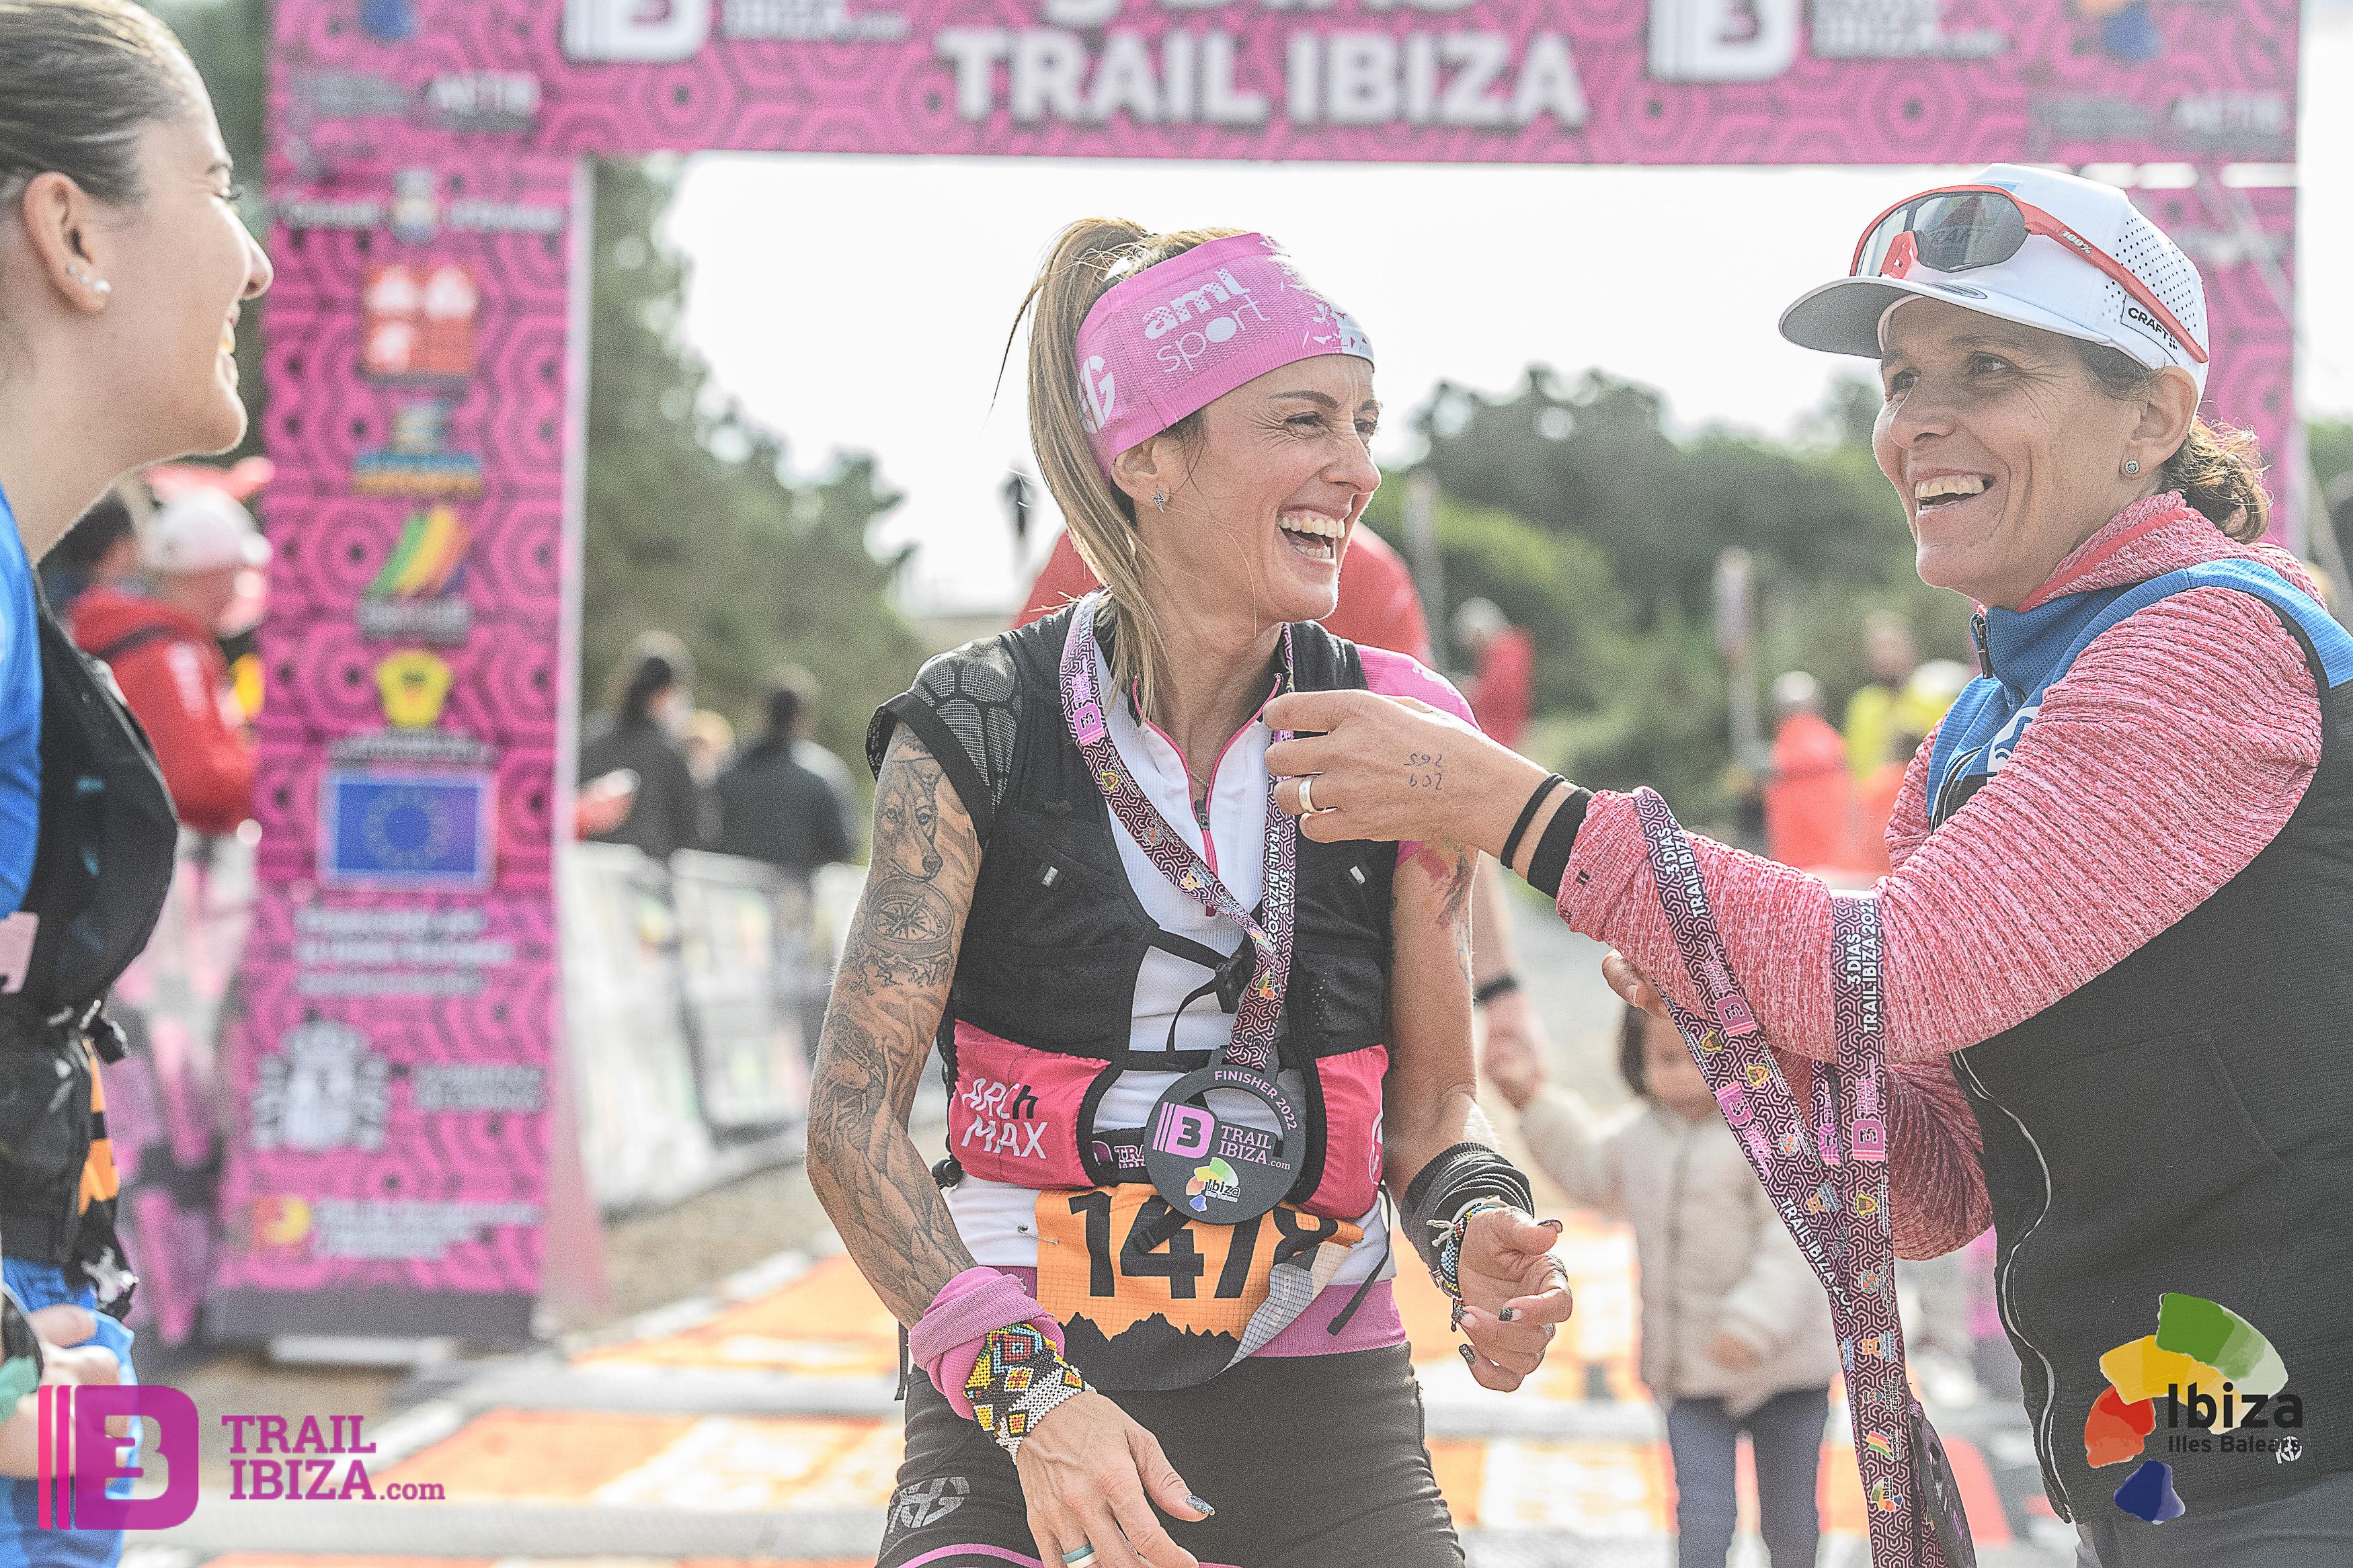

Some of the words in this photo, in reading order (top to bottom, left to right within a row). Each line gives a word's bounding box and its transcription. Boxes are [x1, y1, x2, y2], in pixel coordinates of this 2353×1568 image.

[938, 30, 1269, 124] TRAIL
[1287, 30, 1587, 125] IBIZA
[2061, 229, 2091, 254] 100%
[1156, 294, 1271, 373] sport
[2127, 306, 2171, 341] CRAFT
[1268, 825, 1280, 867] TRAIL
[1657, 827, 1678, 863] DIAS
[1673, 829, 1696, 871] IBIZA
[1267, 868, 1279, 907] IBIZA
[1665, 863, 1680, 875] 3
[1279, 884, 1289, 915] DIAS
[1683, 870, 1707, 918] TRAIL
[1860, 899, 1876, 935] 2022
[1846, 934, 1862, 971] DIAS
[1862, 938, 1877, 981] IBIZA
[1847, 975, 1862, 985] 3
[1862, 986, 1878, 1033] TRAIL
[1214, 1070, 1279, 1102] FINISHER
[1275, 1098, 1298, 1131] 2022
[961, 1120, 1047, 1159] MAX
[1220, 1124, 1272, 1149] TRAIL
[1218, 1141, 1291, 1171] IBIZA.com
[1205, 1178, 1240, 1198] Ibiza
[1780, 1197, 1812, 1243] TRAIL
[1806, 1239, 1837, 1284] IBIZA
